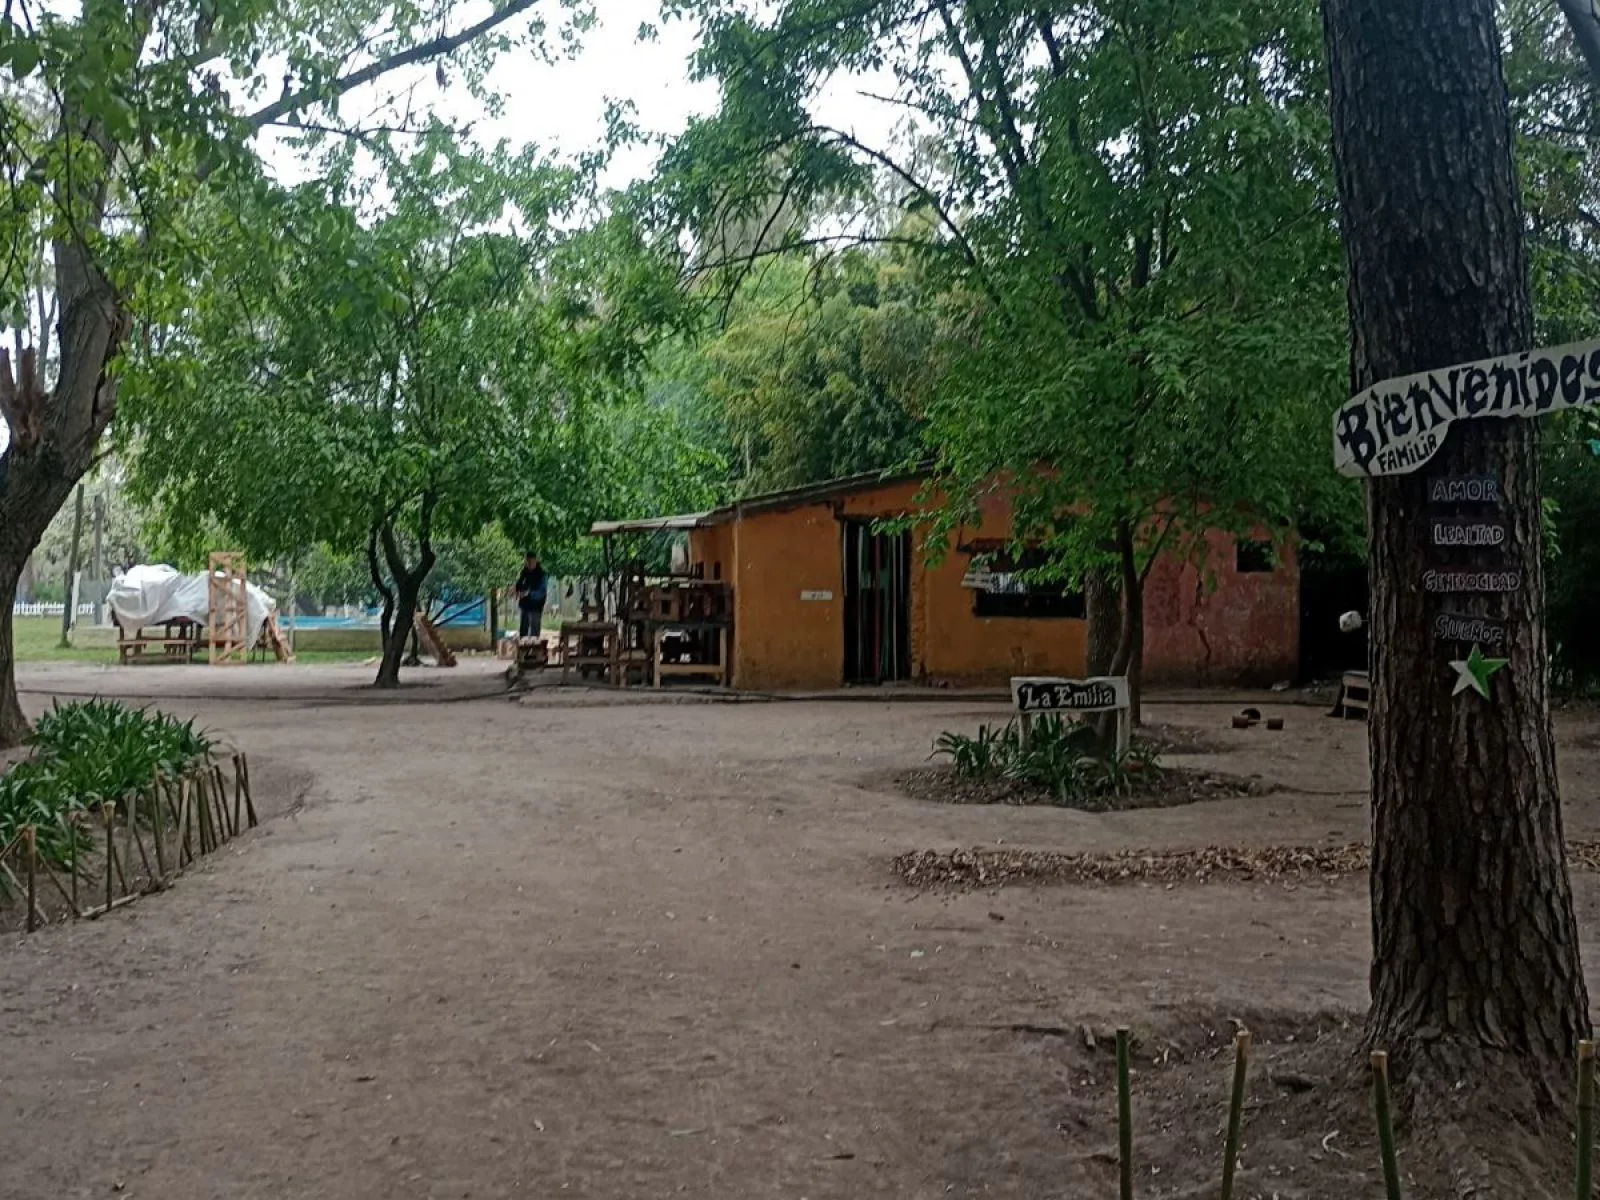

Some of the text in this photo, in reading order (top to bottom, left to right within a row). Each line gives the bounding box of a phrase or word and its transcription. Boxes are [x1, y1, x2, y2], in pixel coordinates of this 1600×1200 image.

[1432, 479, 1499, 500] AMOR
[1021, 684, 1113, 709] La Emilia
